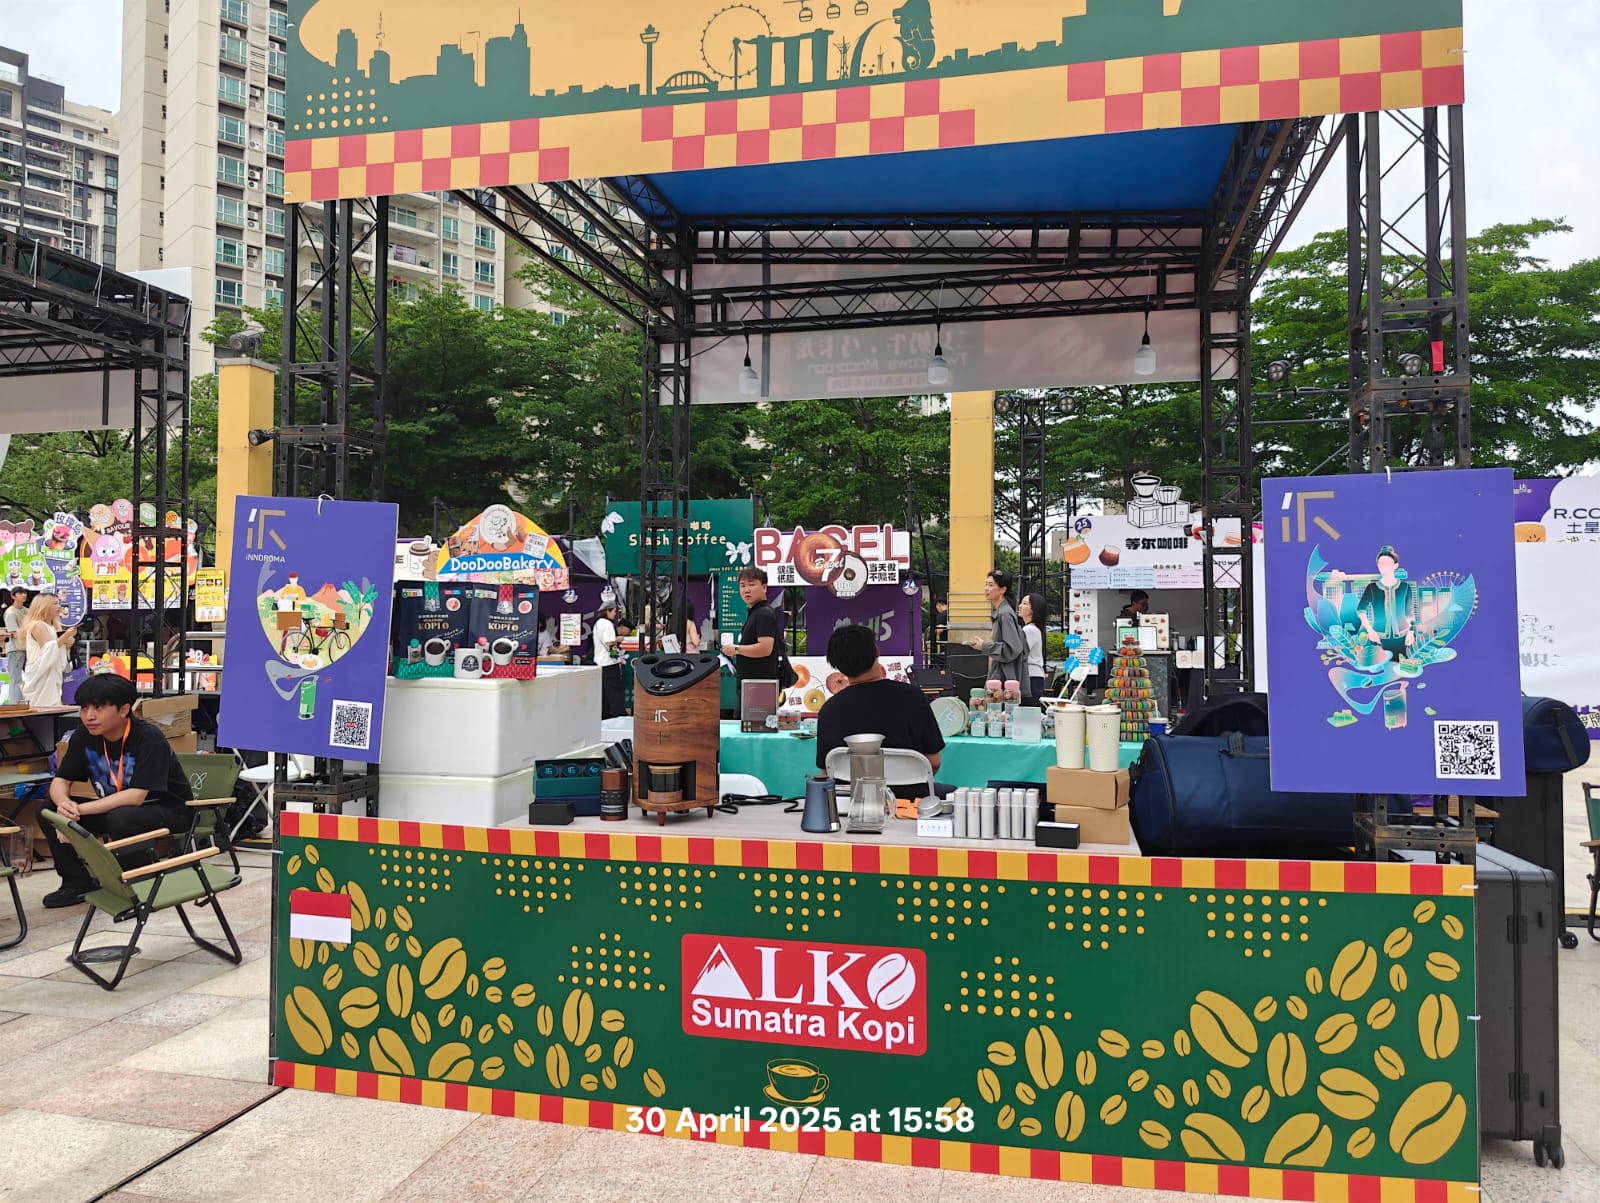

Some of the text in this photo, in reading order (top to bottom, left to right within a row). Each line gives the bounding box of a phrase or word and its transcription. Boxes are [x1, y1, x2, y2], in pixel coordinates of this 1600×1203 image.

[1077, 519, 1088, 529] 25
[678, 533, 727, 545] coffee
[1125, 537, 1189, 550] 等尔咖啡
[95, 563, 118, 575] 广州
[451, 555, 554, 571] DooDooBakery
[418, 622, 442, 631] KOPI
[488, 622, 511, 631] KOPI
[691, 998, 915, 1050] Sumatra Kopi
